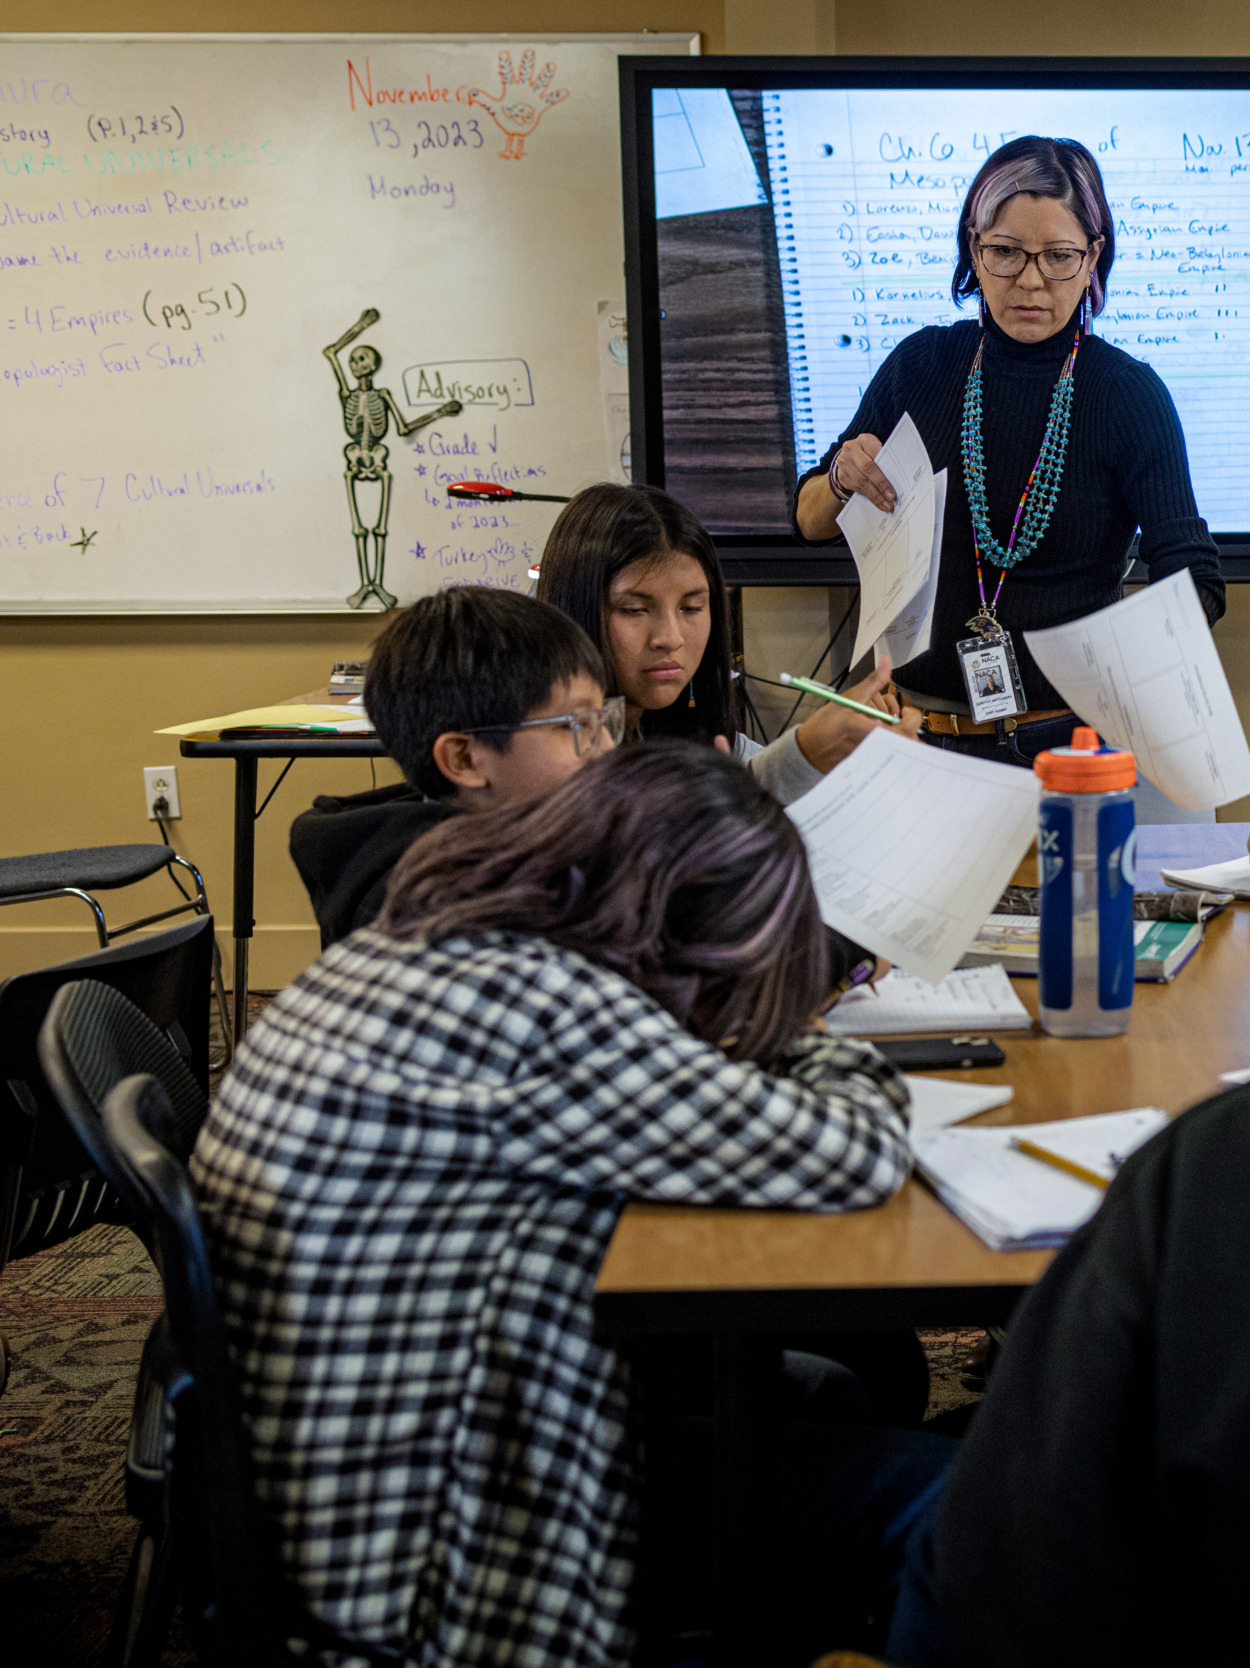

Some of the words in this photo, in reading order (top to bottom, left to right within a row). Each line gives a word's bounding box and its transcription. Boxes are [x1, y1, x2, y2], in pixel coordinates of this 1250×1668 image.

[0, 78, 87, 107] ura
[346, 56, 469, 111] November
[84, 139, 281, 175] UNIVERSALS
[929, 131, 955, 162] 6
[1098, 125, 1120, 152] of
[72, 197, 152, 219] Universal
[163, 189, 249, 214] Review
[367, 174, 456, 209] Monday
[1130, 195, 1180, 214] Empire
[1116, 219, 1184, 241] Assyrian
[1187, 218, 1232, 236] Empire
[0, 254, 41, 271] ame
[49, 245, 84, 264] the
[1176, 261, 1228, 276] Empire
[24, 305, 43, 333] 4
[49, 304, 134, 336] Empires
[1156, 306, 1200, 321] Empire
[99, 342, 141, 374] Fact
[428, 431, 480, 458] Grade
[44, 470, 67, 508] of
[79, 475, 105, 510] 7
[125, 472, 190, 503] Cultural
[196, 466, 275, 499] Universals
[431, 544, 488, 575] Turkey
[981, 655, 1001, 664] NACA
